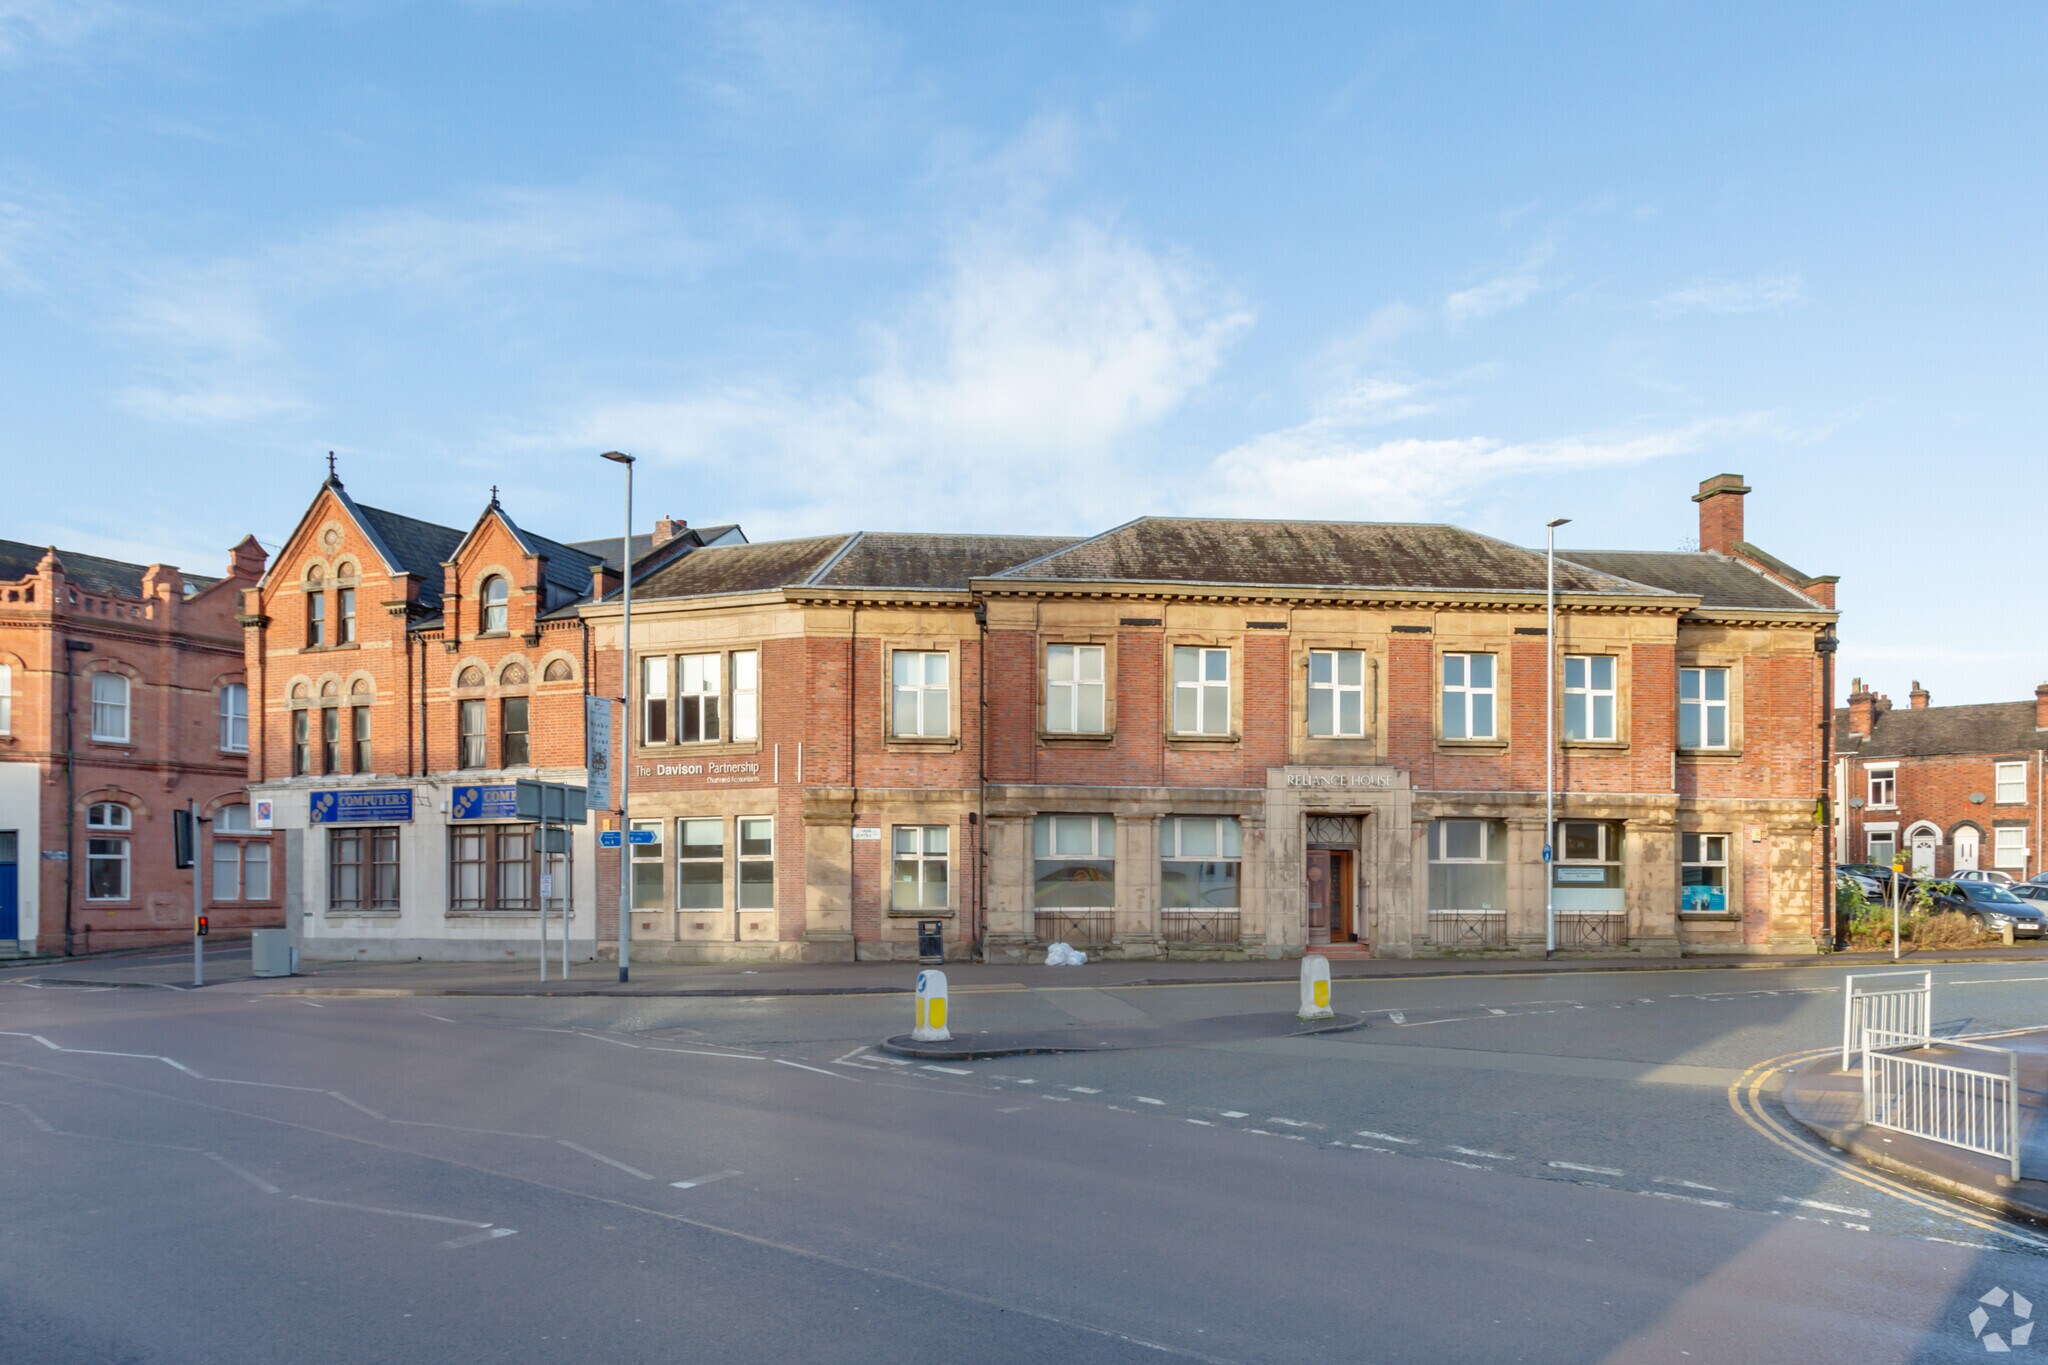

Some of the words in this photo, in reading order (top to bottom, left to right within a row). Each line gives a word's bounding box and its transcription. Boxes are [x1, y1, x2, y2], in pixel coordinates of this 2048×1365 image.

[635, 765, 652, 777] The
[656, 763, 703, 776] Davison
[708, 761, 760, 775] Partnership
[1287, 774, 1347, 786] RELIANCE
[1351, 774, 1393, 786] HOUSE
[339, 793, 408, 807] COMPUTERS
